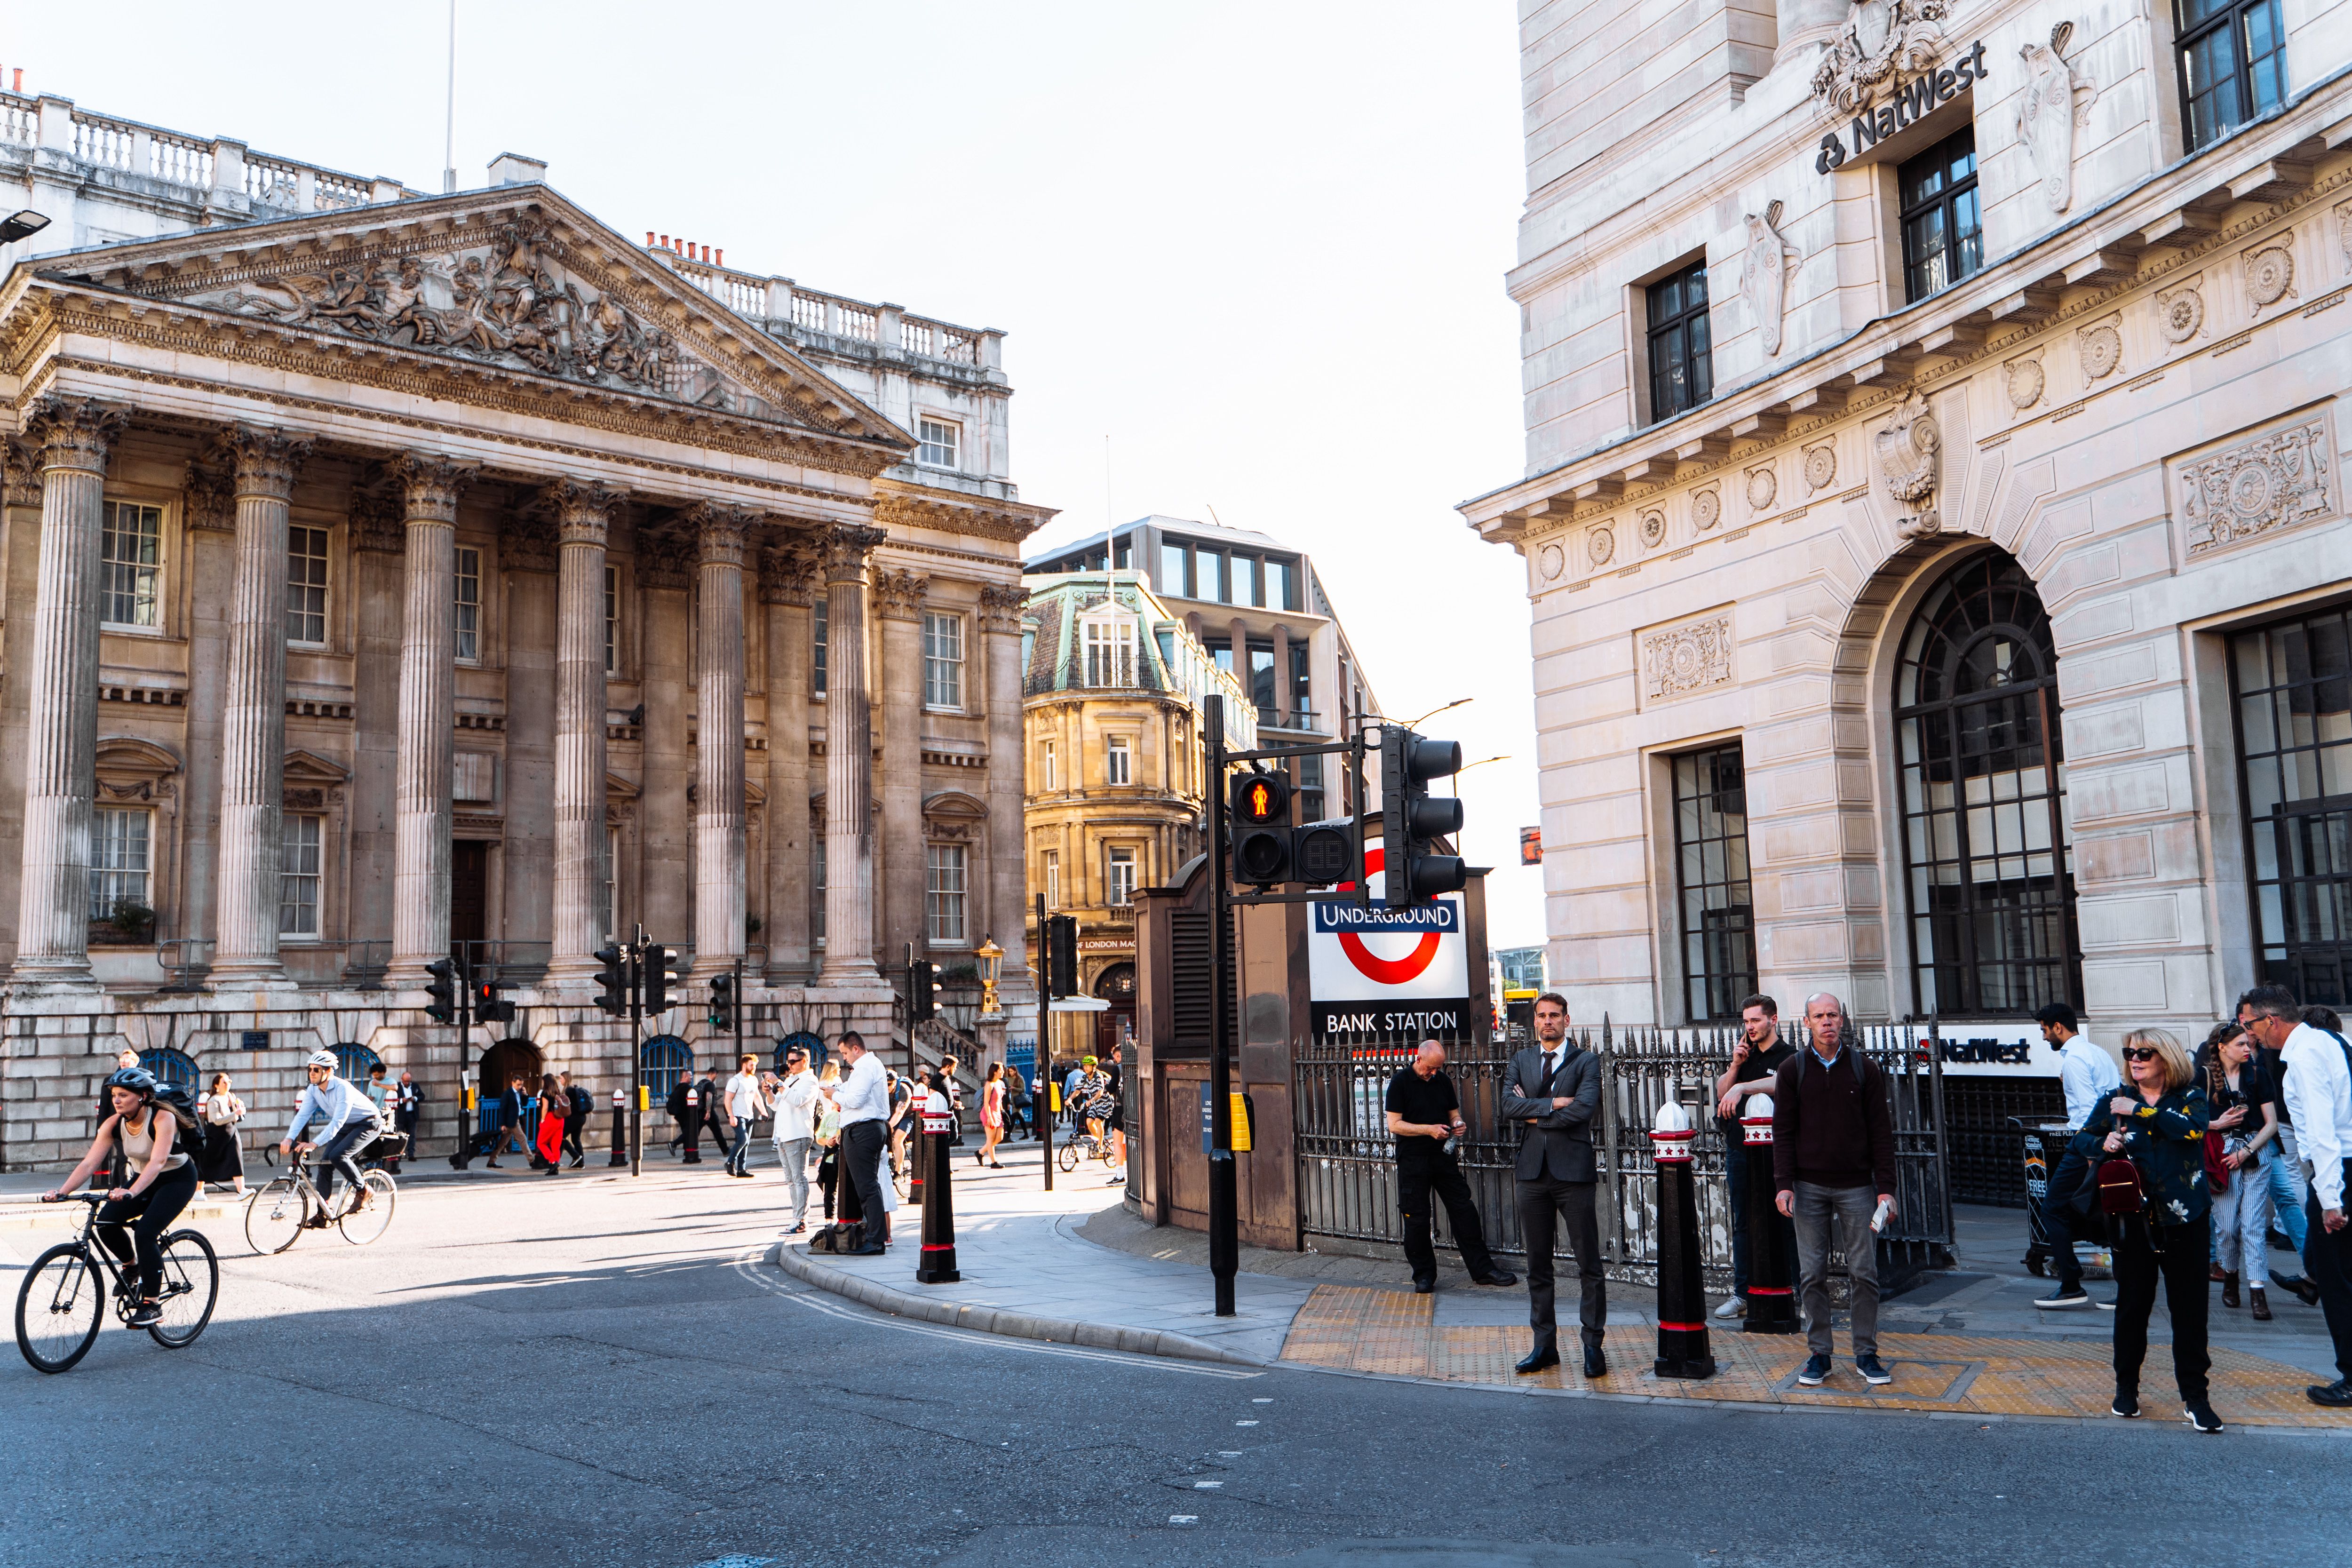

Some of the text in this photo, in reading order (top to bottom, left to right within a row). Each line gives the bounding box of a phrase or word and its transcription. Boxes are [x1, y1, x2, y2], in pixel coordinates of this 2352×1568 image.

[1851, 40, 1988, 154] NatWest
[1322, 905, 1451, 926] UNDERGROUND
[1327, 1011, 1456, 1033] BANK STATION
[1939, 1038, 2031, 1063] NatWest
[2029, 1179, 2046, 1193] FREE
